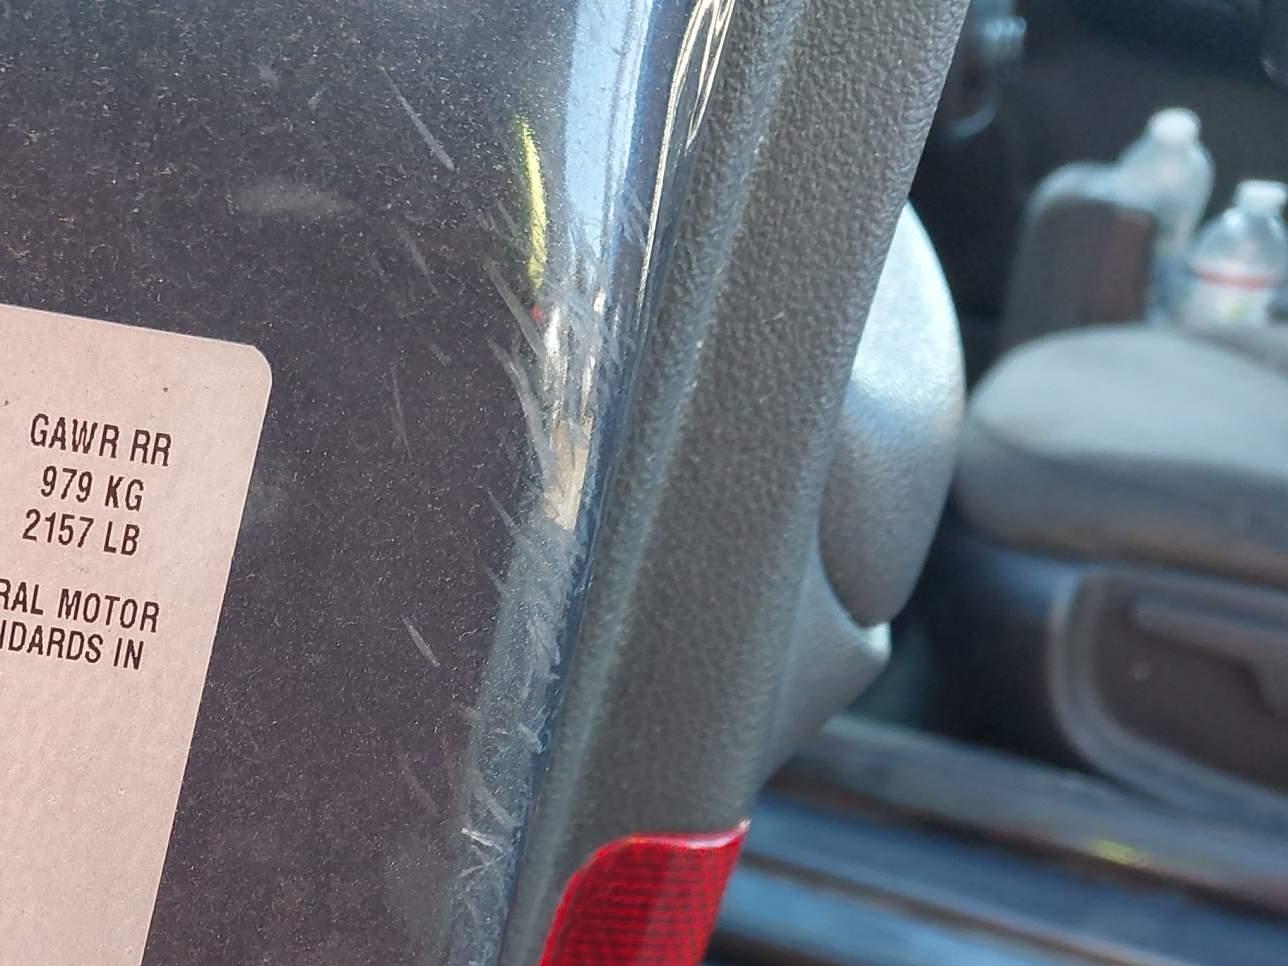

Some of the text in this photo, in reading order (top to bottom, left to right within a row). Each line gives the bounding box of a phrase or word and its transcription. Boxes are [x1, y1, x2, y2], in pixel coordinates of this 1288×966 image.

[30, 413, 173, 467] GAWR RR
[40, 465, 144, 512] 979 KG
[22, 510, 140, 557] 2157 LB
[57, 588, 159, 633] MOTOR
[115, 638, 143, 670] IN
